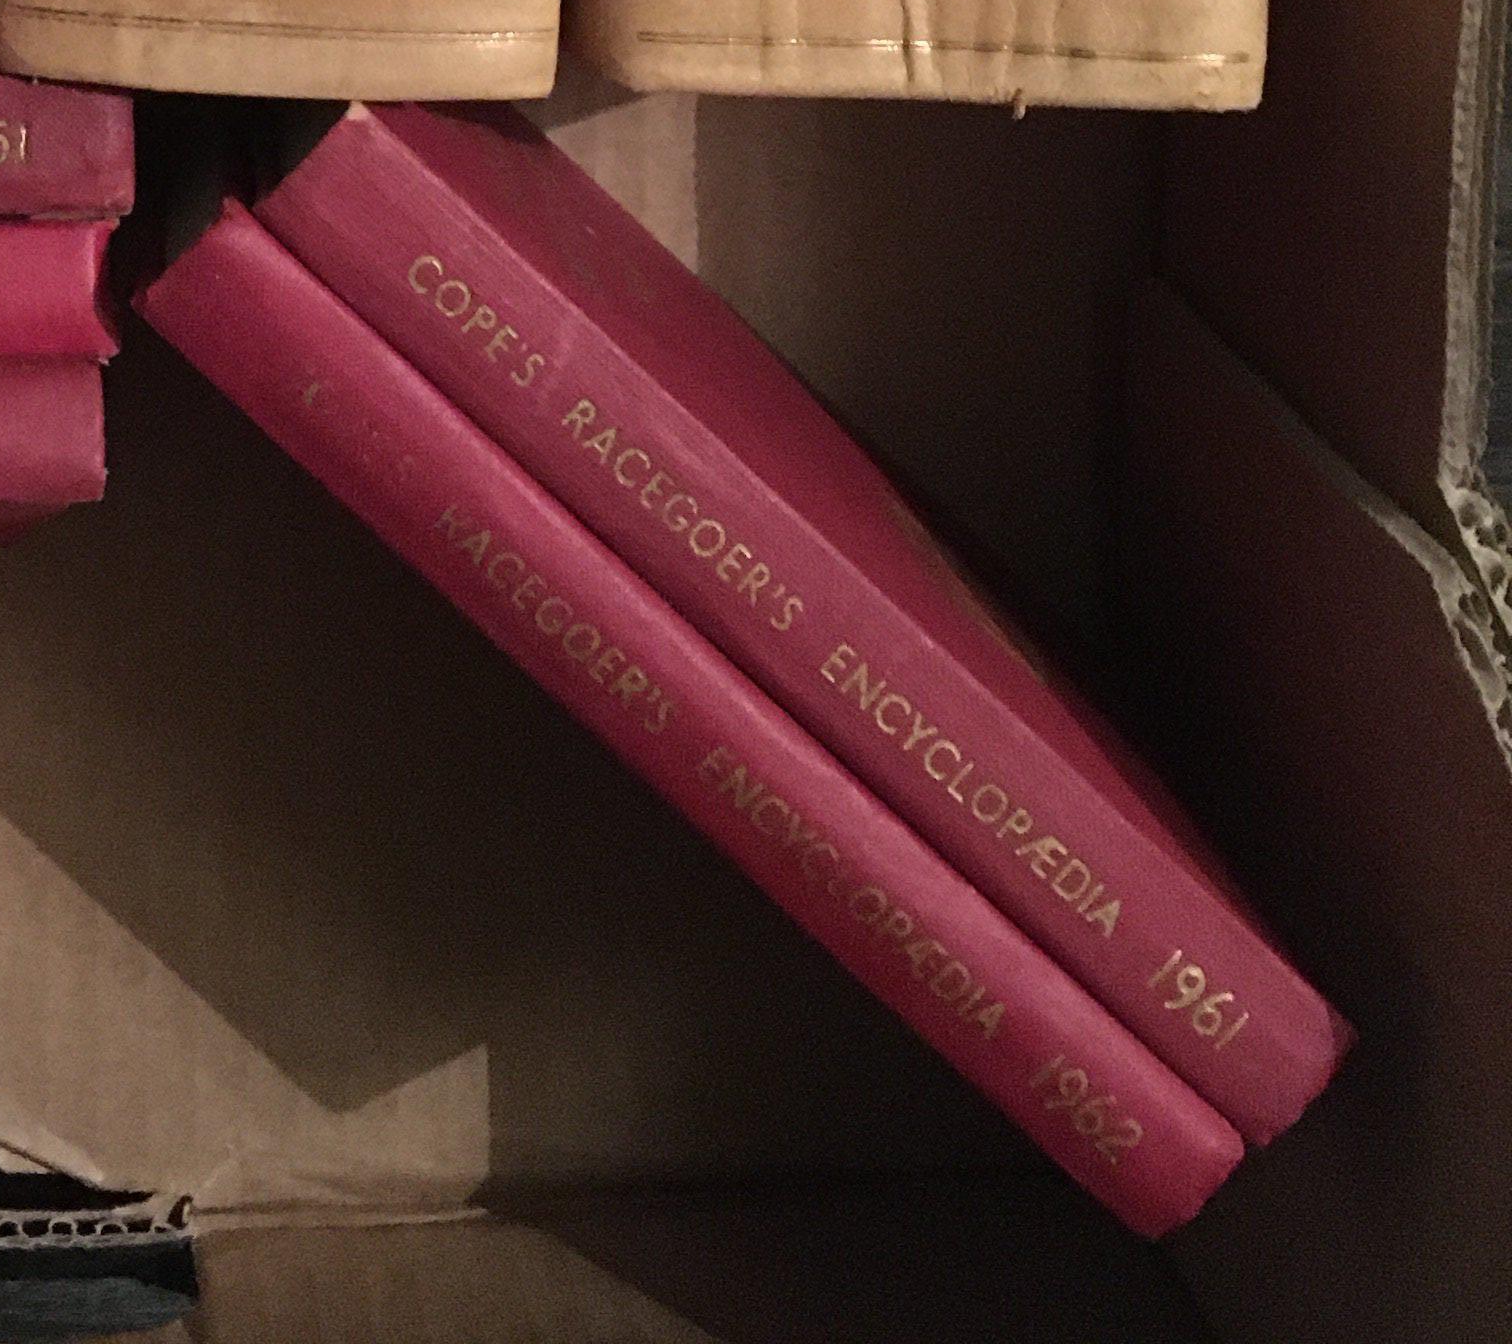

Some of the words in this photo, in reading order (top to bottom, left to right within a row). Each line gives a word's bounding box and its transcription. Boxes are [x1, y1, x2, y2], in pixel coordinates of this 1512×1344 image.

[407, 255, 545, 388] COPE'S
[563, 397, 804, 632] RACEGOER'S
[1147, 949, 1249, 1050] 1961
[1030, 1055, 1143, 1164] 1962
